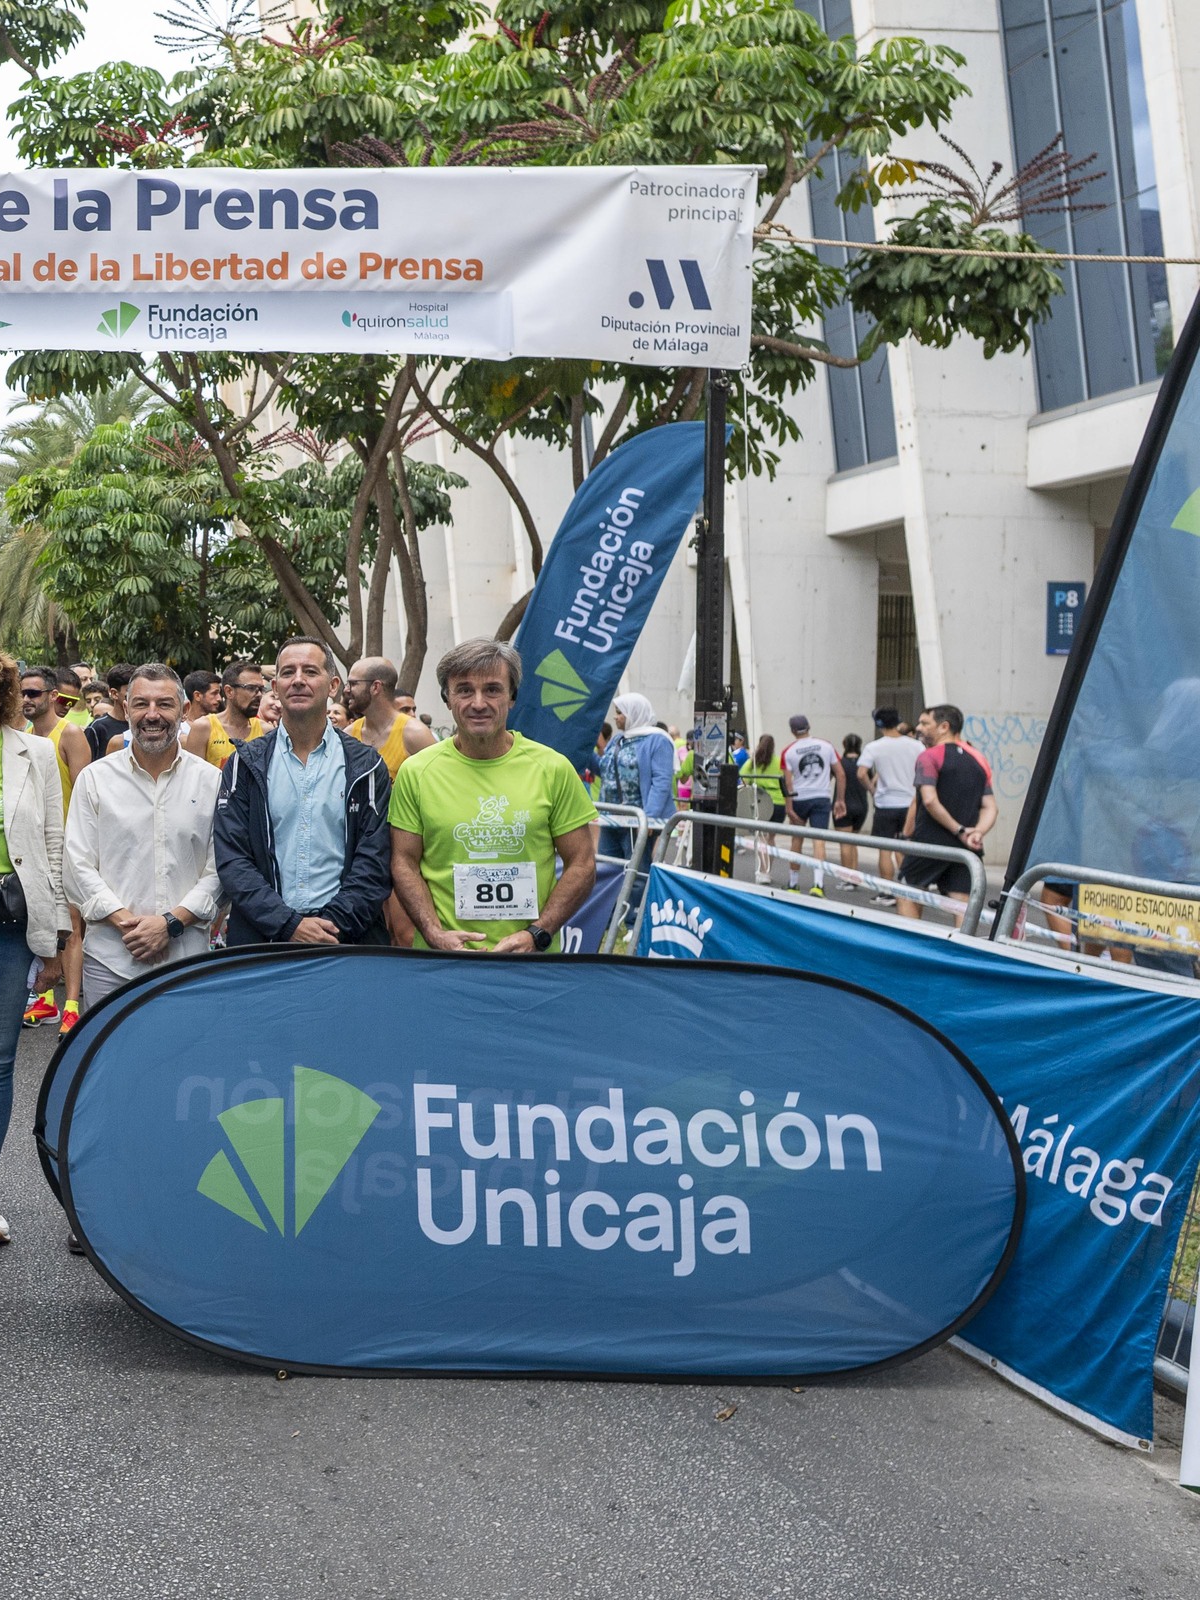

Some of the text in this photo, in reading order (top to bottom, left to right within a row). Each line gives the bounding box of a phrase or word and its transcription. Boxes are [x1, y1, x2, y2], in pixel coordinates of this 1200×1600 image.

[629, 181, 745, 200] Patrocinadora
[53, 178, 112, 232] la
[136, 178, 379, 232] Prensa
[32, 253, 78, 282] de
[90, 253, 120, 282] la
[133, 251, 289, 282] Libertad
[301, 251, 347, 281] de
[359, 252, 483, 281] Prensa
[148, 303, 259, 323] Fundación
[408, 302, 449, 314] Hospital
[357, 313, 449, 331] quirónsalud
[601, 316, 740, 337] Diputación Provincial
[147, 324, 228, 344] Unicaja
[413, 331, 450, 341] Málaga
[632, 338, 709, 354] de Málaga
[553, 486, 645, 644] Fundación
[582, 540, 655, 654] Unicaja
[476, 883, 514, 903] 80
[1084, 890, 1133, 912] PROHIBIDO
[1135, 897, 1195, 921] ESTACIONAR
[412, 1082, 883, 1172] Fundación
[416, 1166, 752, 1277] Unicaja
